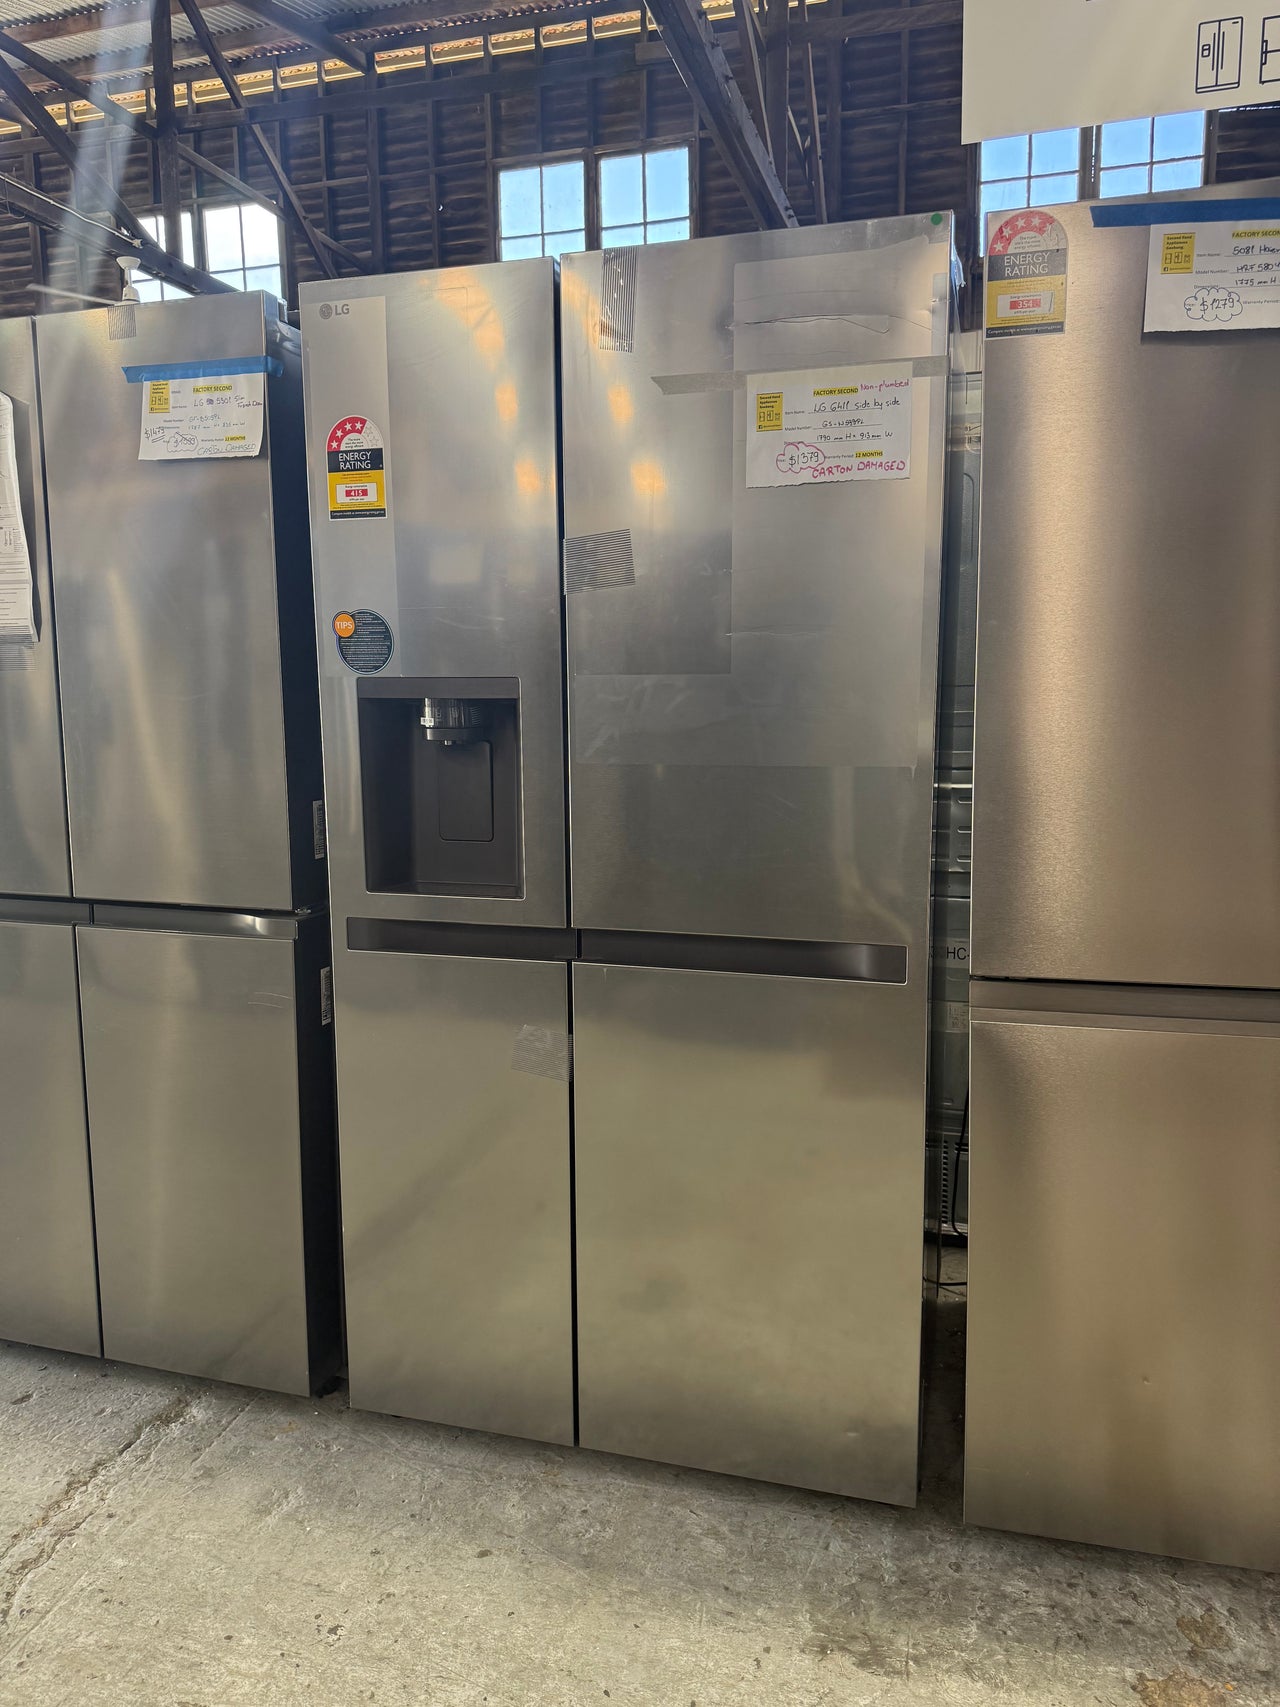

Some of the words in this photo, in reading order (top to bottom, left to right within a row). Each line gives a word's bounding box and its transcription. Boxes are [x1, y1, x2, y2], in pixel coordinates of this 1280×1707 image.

[1232, 230, 1259, 238] FACTORY
[1004, 252, 1050, 266] ENERGY
[1005, 264, 1048, 277] RATING
[334, 304, 350, 316] LG
[1200, 296, 1234, 314] $1279
[854, 400, 870, 410] side
[874, 398, 883, 410] by
[886, 396, 901, 407] side
[338, 452, 371, 462] ENERGY
[788, 451, 819, 468] $1379
[340, 460, 371, 470] RATING
[812, 464, 853, 479] CARTON
[857, 460, 906, 471] DAMAGED
